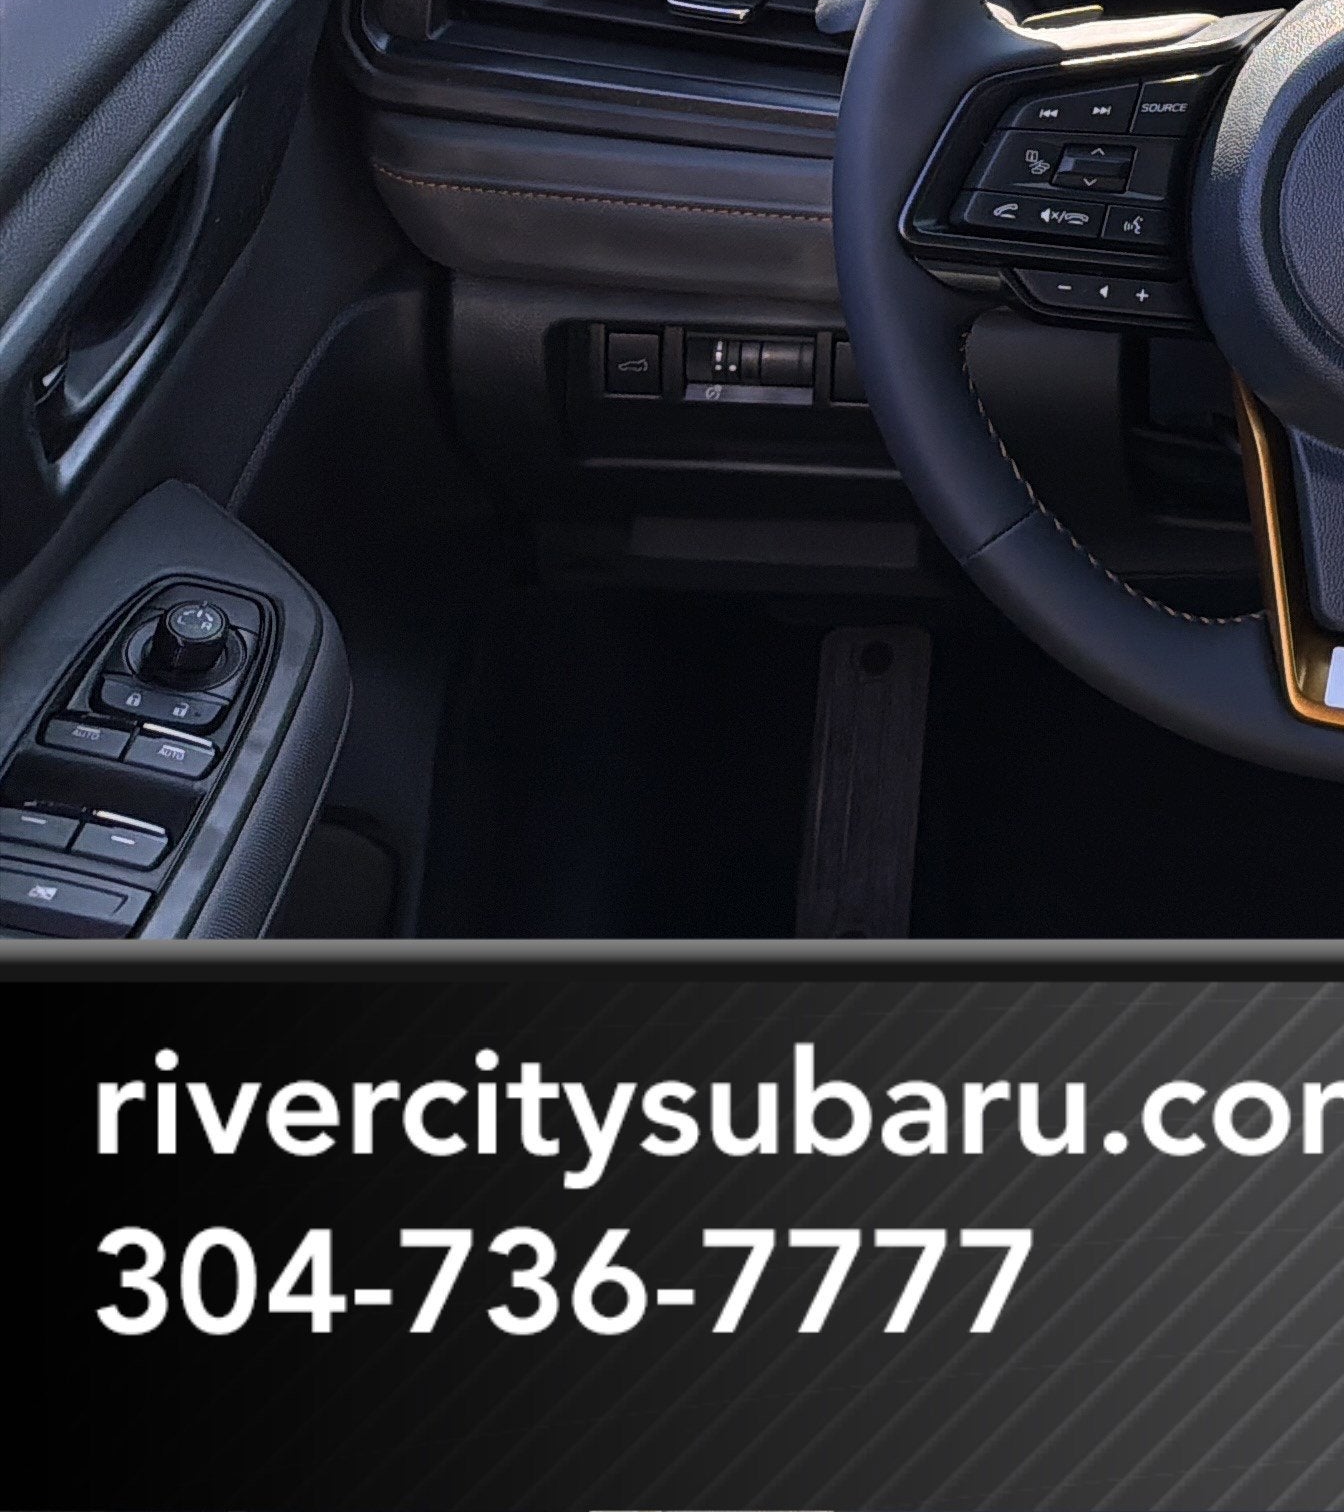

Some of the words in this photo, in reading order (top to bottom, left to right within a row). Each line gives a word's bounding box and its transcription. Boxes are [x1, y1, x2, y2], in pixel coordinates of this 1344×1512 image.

[1141, 102, 1189, 113] SOURCE
[72, 729, 100, 740] AUTO
[158, 749, 186, 761] AUTO
